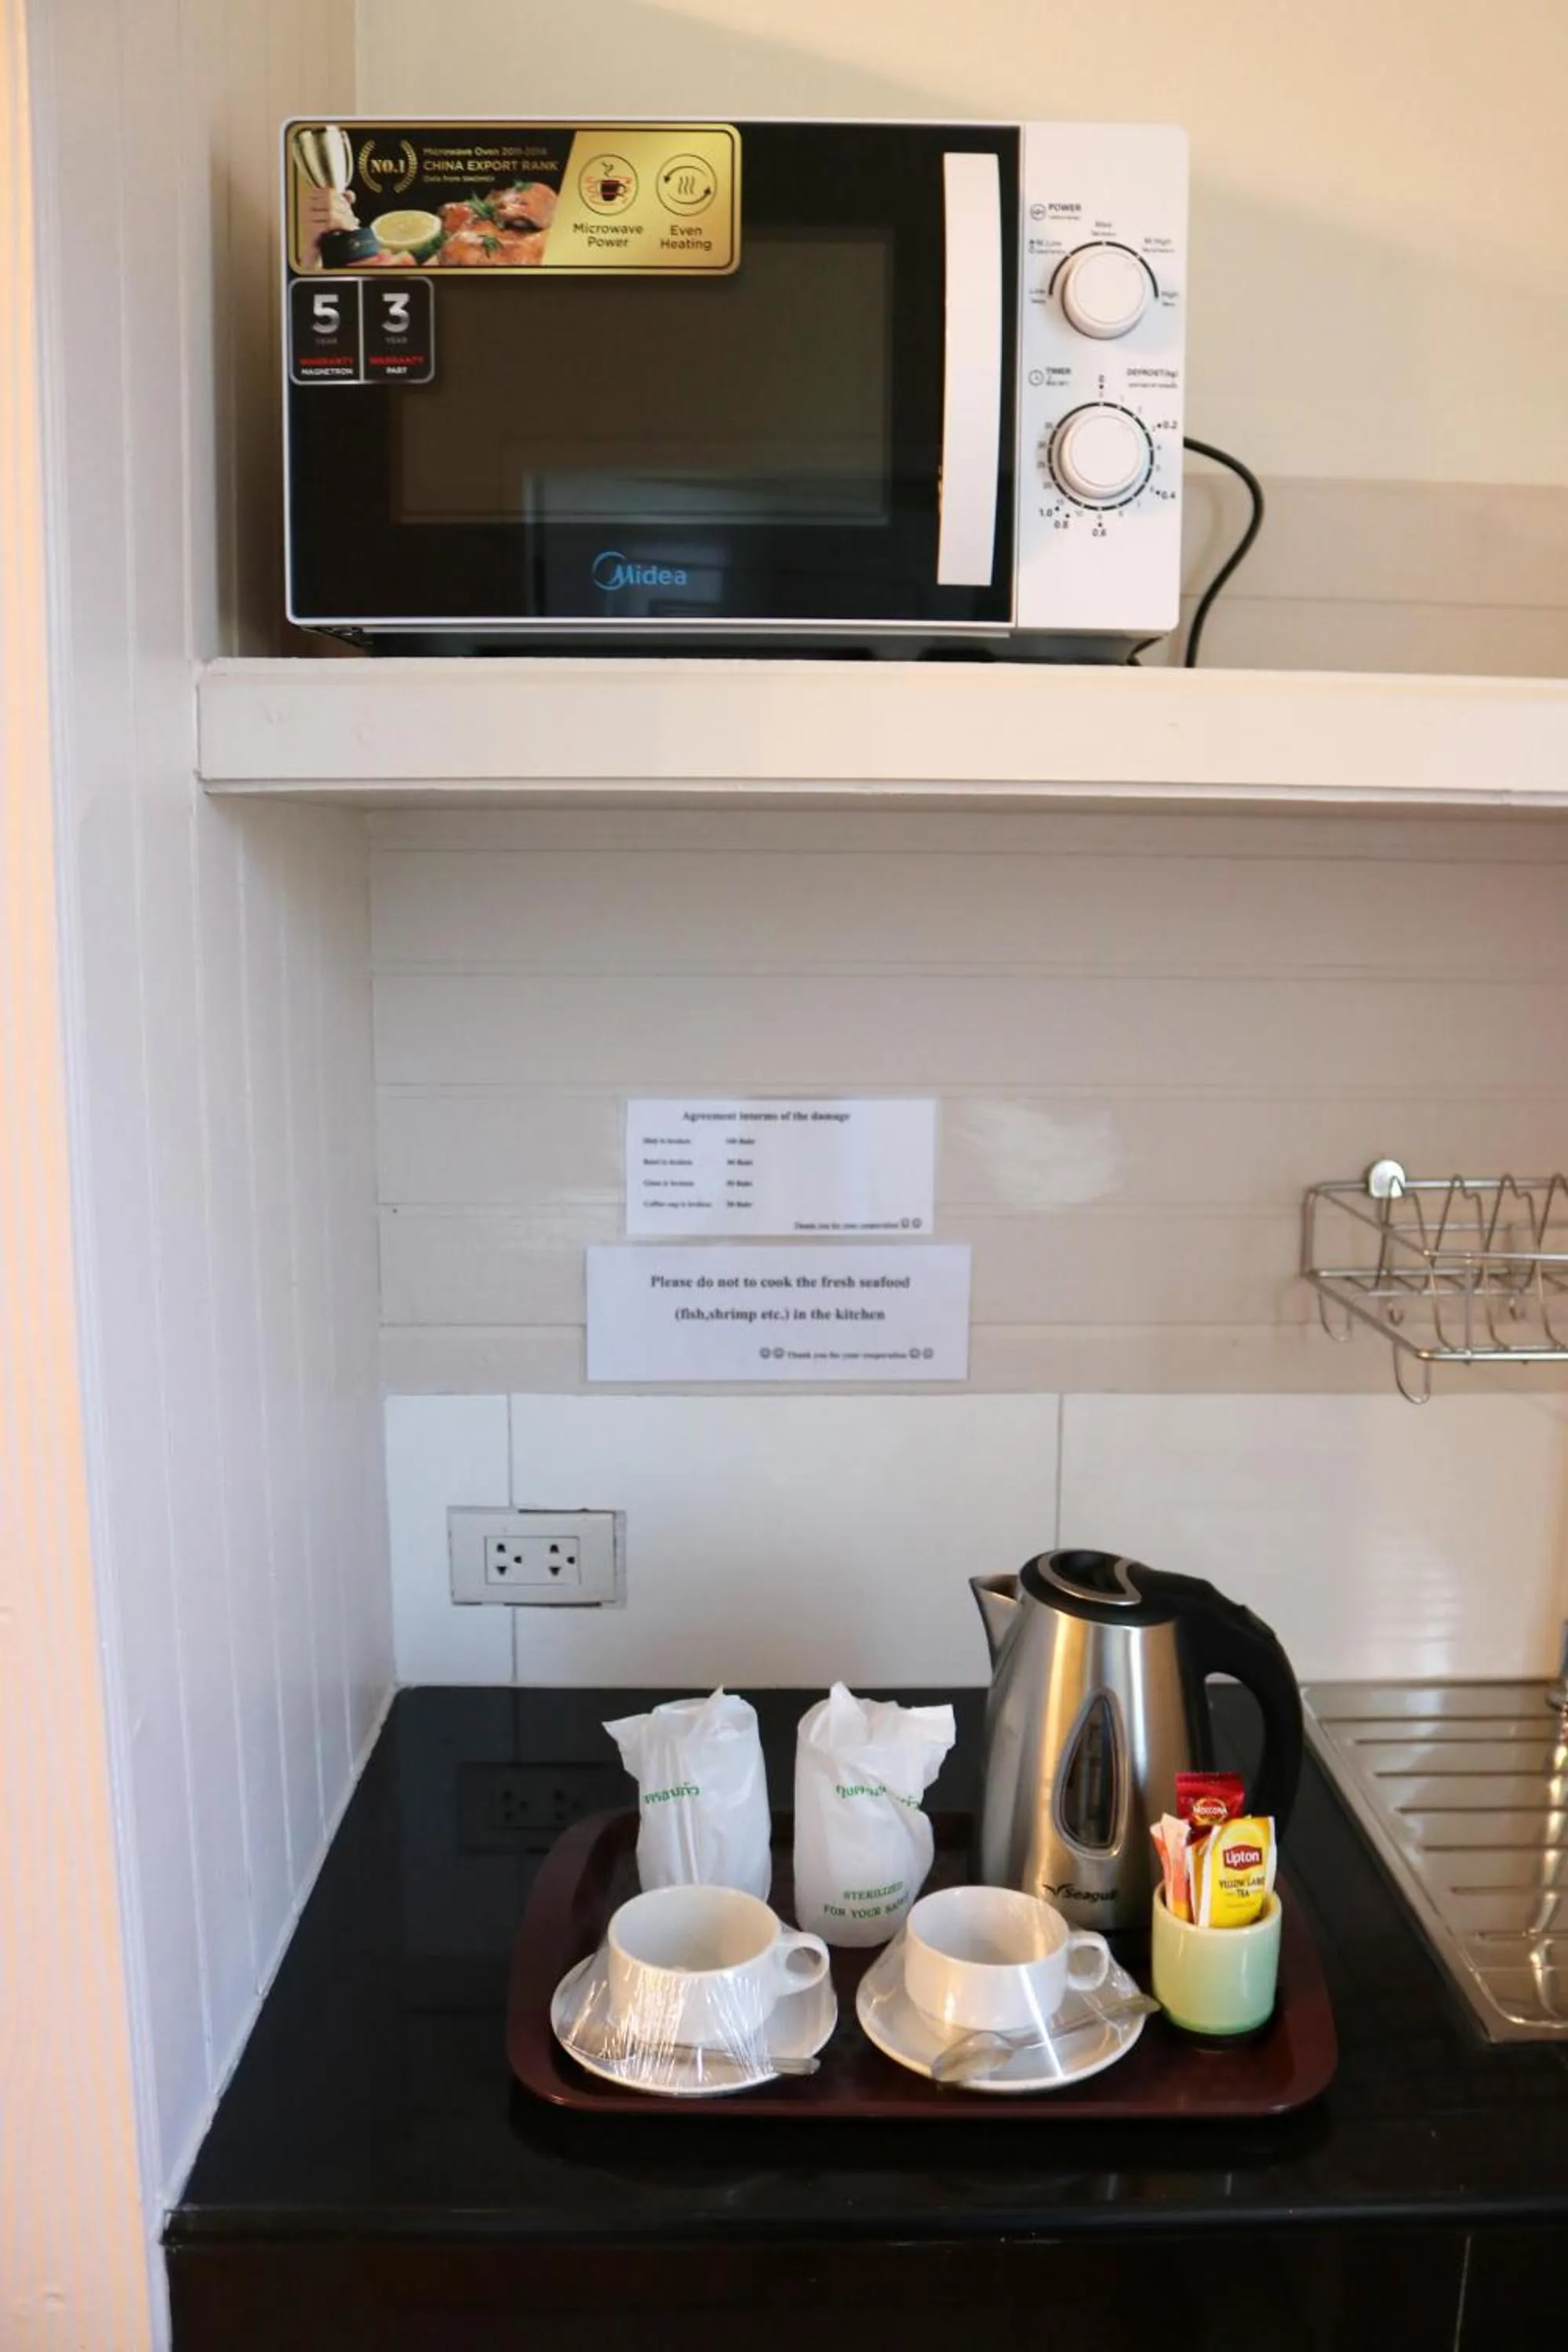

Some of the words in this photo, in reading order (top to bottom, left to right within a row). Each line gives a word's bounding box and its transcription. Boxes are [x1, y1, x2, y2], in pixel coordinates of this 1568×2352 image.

[474, 147, 500, 157] Oven
[371, 159, 405, 174] NO.1
[423, 161, 464, 172] CHINA
[466, 161, 519, 172] EXPORT
[521, 160, 559, 172] RANK
[1048, 203, 1082, 212] POWER
[573, 223, 644, 235] Microwave
[670, 224, 702, 236] Even
[588, 236, 629, 248] Power
[660, 238, 713, 252] Heating
[311, 293, 340, 334] 5
[381, 292, 410, 333] 3
[1040, 508, 1053, 517] 1.0
[605, 561, 688, 587] Midea
[683, 1111, 736, 1123] Agreement
[780, 1111, 792, 1121] of
[793, 1111, 808, 1121] the
[811, 1111, 850, 1123] damage
[651, 1276, 692, 1288] Please
[697, 1276, 713, 1288] do
[717, 1276, 739, 1288] not
[743, 1276, 757, 1288] to
[760, 1276, 792, 1288] cook
[796, 1276, 816, 1288] the
[821, 1276, 855, 1288] fresh
[859, 1276, 911, 1288] seafood
[760, 1308, 789, 1322] etc.)
[793, 1308, 806, 1319] in
[810, 1308, 831, 1319] the
[835, 1308, 886, 1319] kitchen
[1225, 1851, 1260, 1867] Lipton
[1236, 1889, 1250, 1898] TEA
[823, 1904, 846, 1916] FOR
[851, 1906, 881, 1918] YOUR
